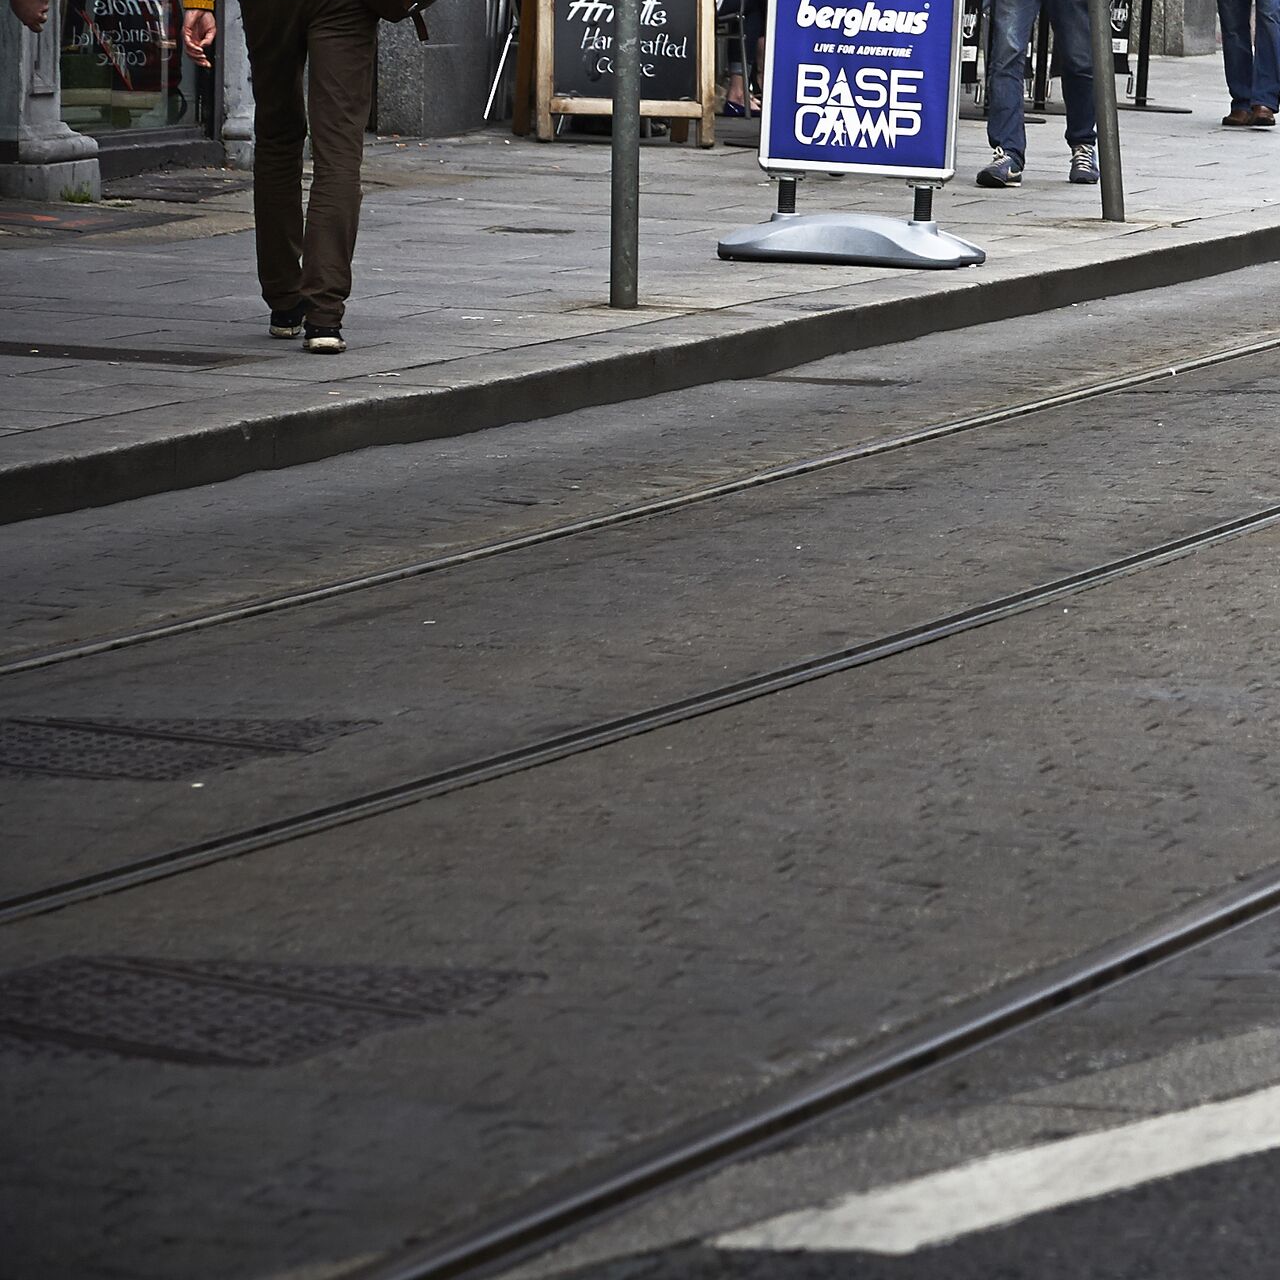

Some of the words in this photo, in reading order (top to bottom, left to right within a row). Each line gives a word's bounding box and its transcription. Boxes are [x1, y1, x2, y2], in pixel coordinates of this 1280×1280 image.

[814, 43, 835, 53] LIVE
[837, 45, 855, 55] FOR
[856, 45, 912, 58] ADVENTURE
[796, 64, 924, 111] BASE
[794, 105, 922, 149] CAMP
